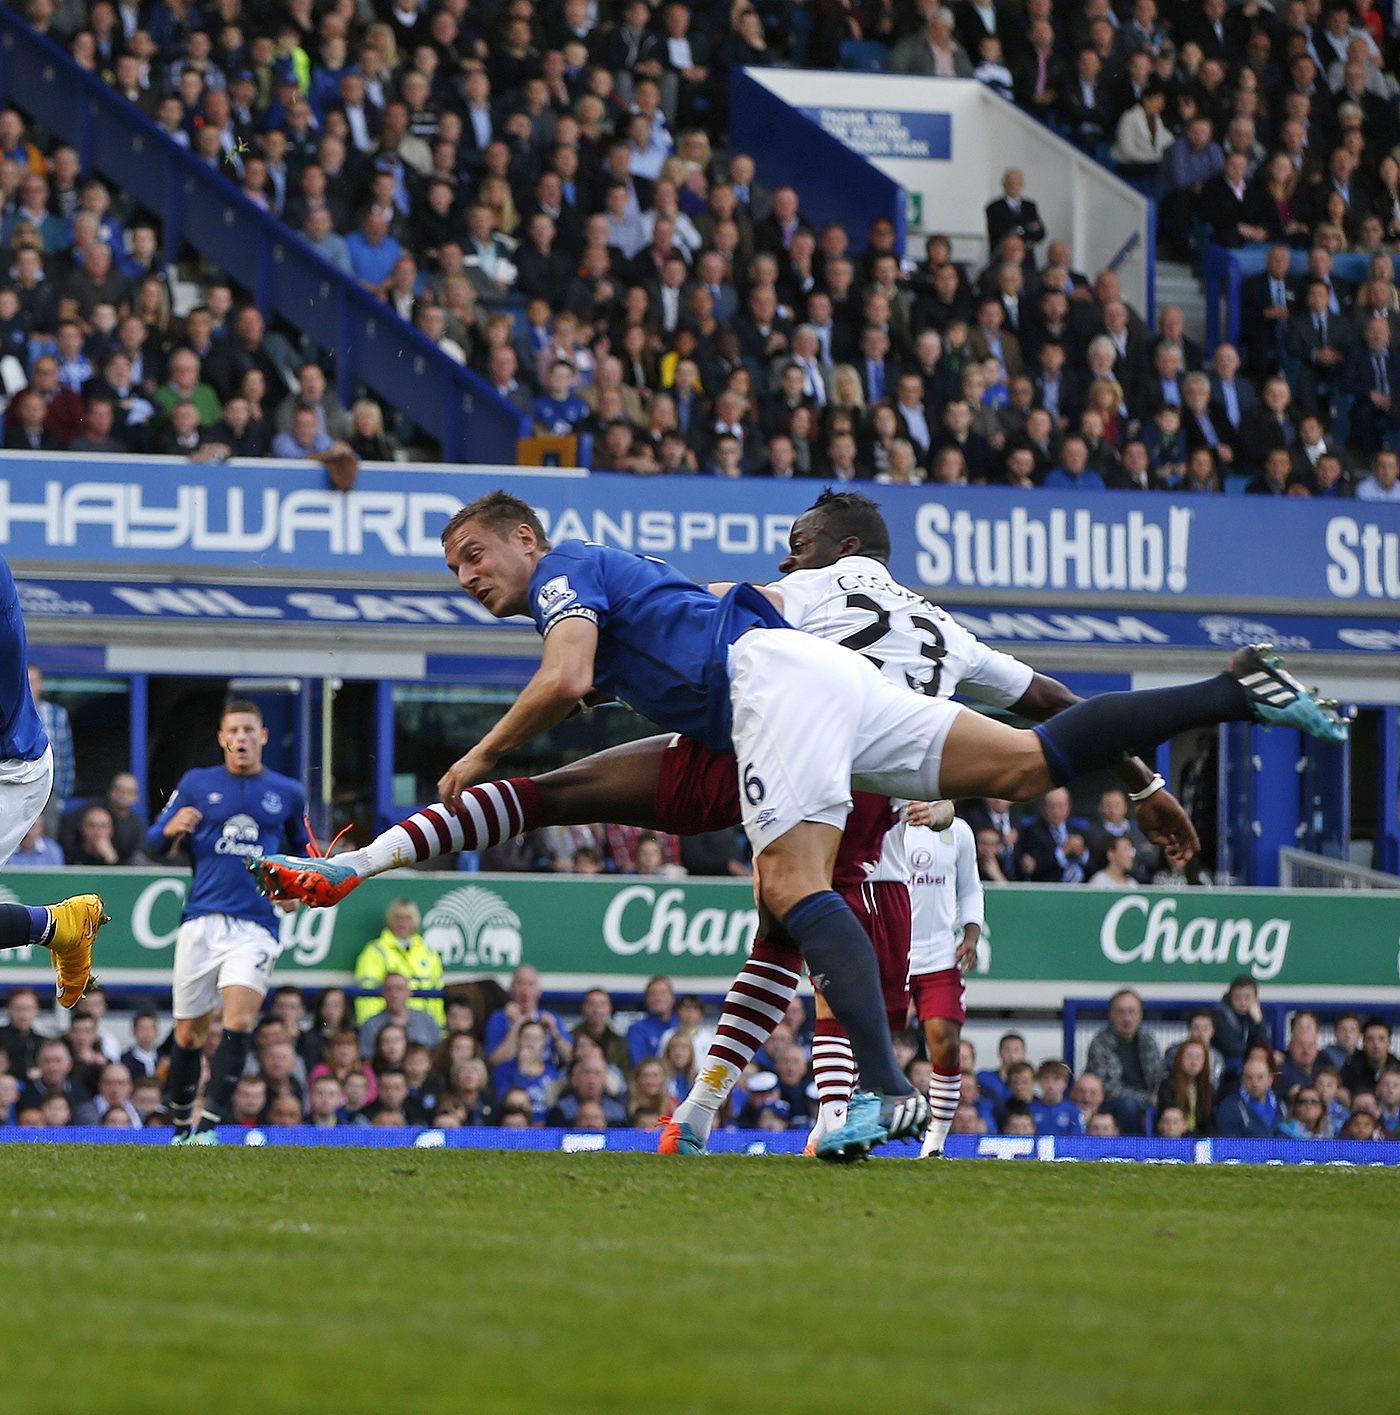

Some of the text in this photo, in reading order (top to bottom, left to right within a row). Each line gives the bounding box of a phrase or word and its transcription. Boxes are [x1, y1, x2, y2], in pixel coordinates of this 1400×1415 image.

[536, 506, 798, 557] ANSPOR
[915, 502, 1191, 593] StubHub!
[837, 593, 949, 698] 23
[743, 761, 765, 806] 6
[602, 884, 760, 957] Chan
[1100, 894, 1292, 980] Chang
